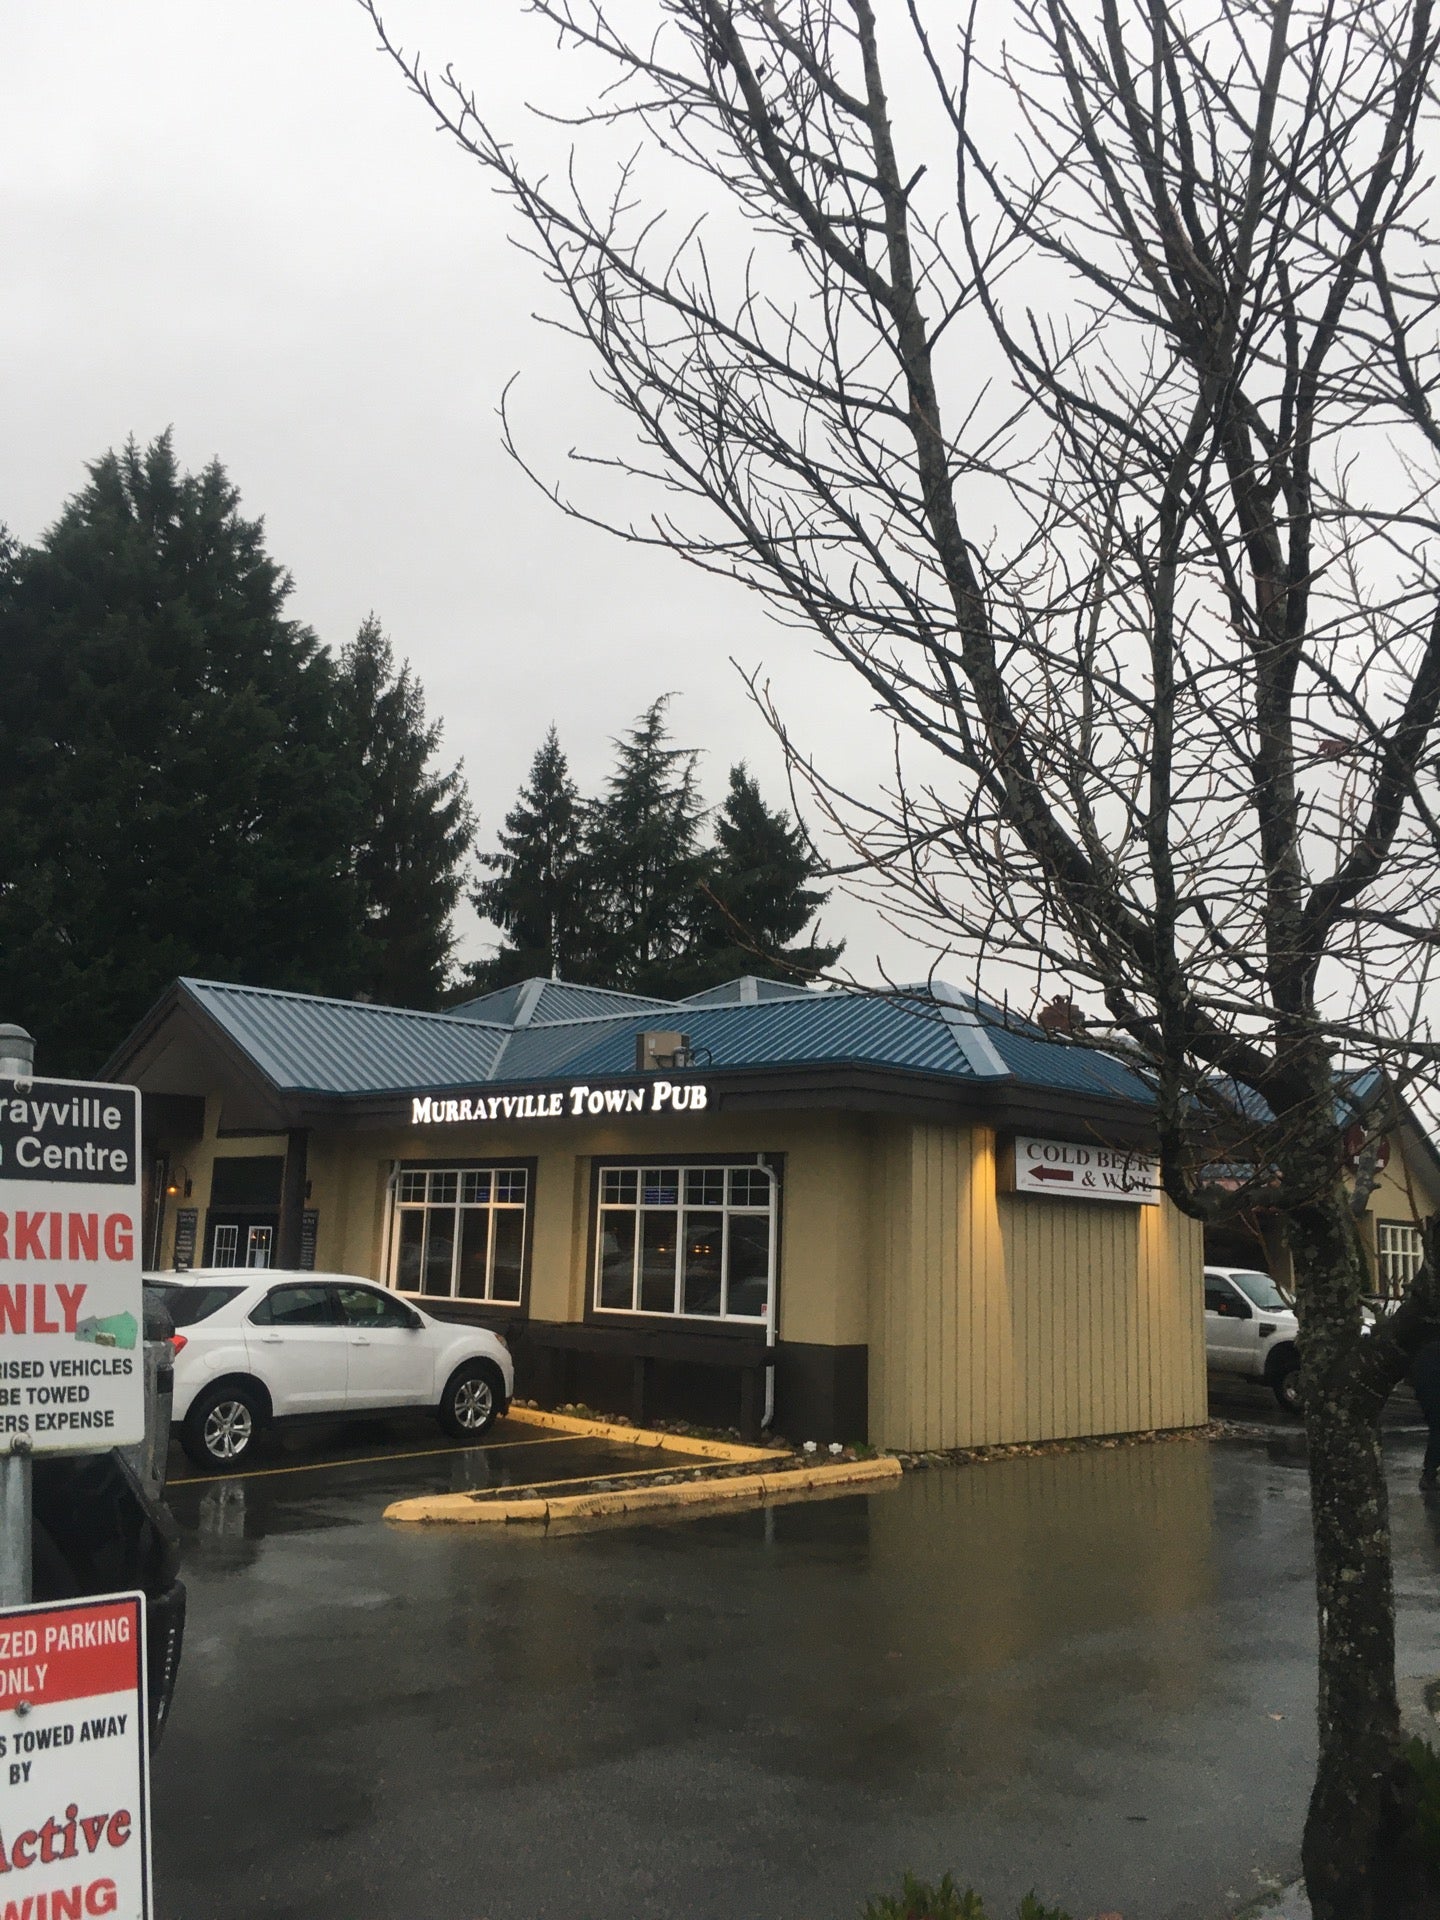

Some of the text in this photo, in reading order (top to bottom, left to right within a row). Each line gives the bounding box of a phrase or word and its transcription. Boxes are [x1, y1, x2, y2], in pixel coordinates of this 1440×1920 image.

[412, 1081, 707, 1124] MURRAYVILLE TOWN PUB
[16, 1136, 128, 1172] Centre
[1026, 1143, 1090, 1165] COLD
[1082, 1170, 1152, 1192] & WNE
[0, 1358, 133, 1379] ISED VEHICLES
[0, 1385, 90, 1405] BE TOWED
[35, 1410, 114, 1431] EXPENSE
[45, 1616, 130, 1653] PARKING
[13, 1724, 74, 1754] TOWED
[80, 1714, 128, 1742] AWAY
[9, 1761, 32, 1785] BY
